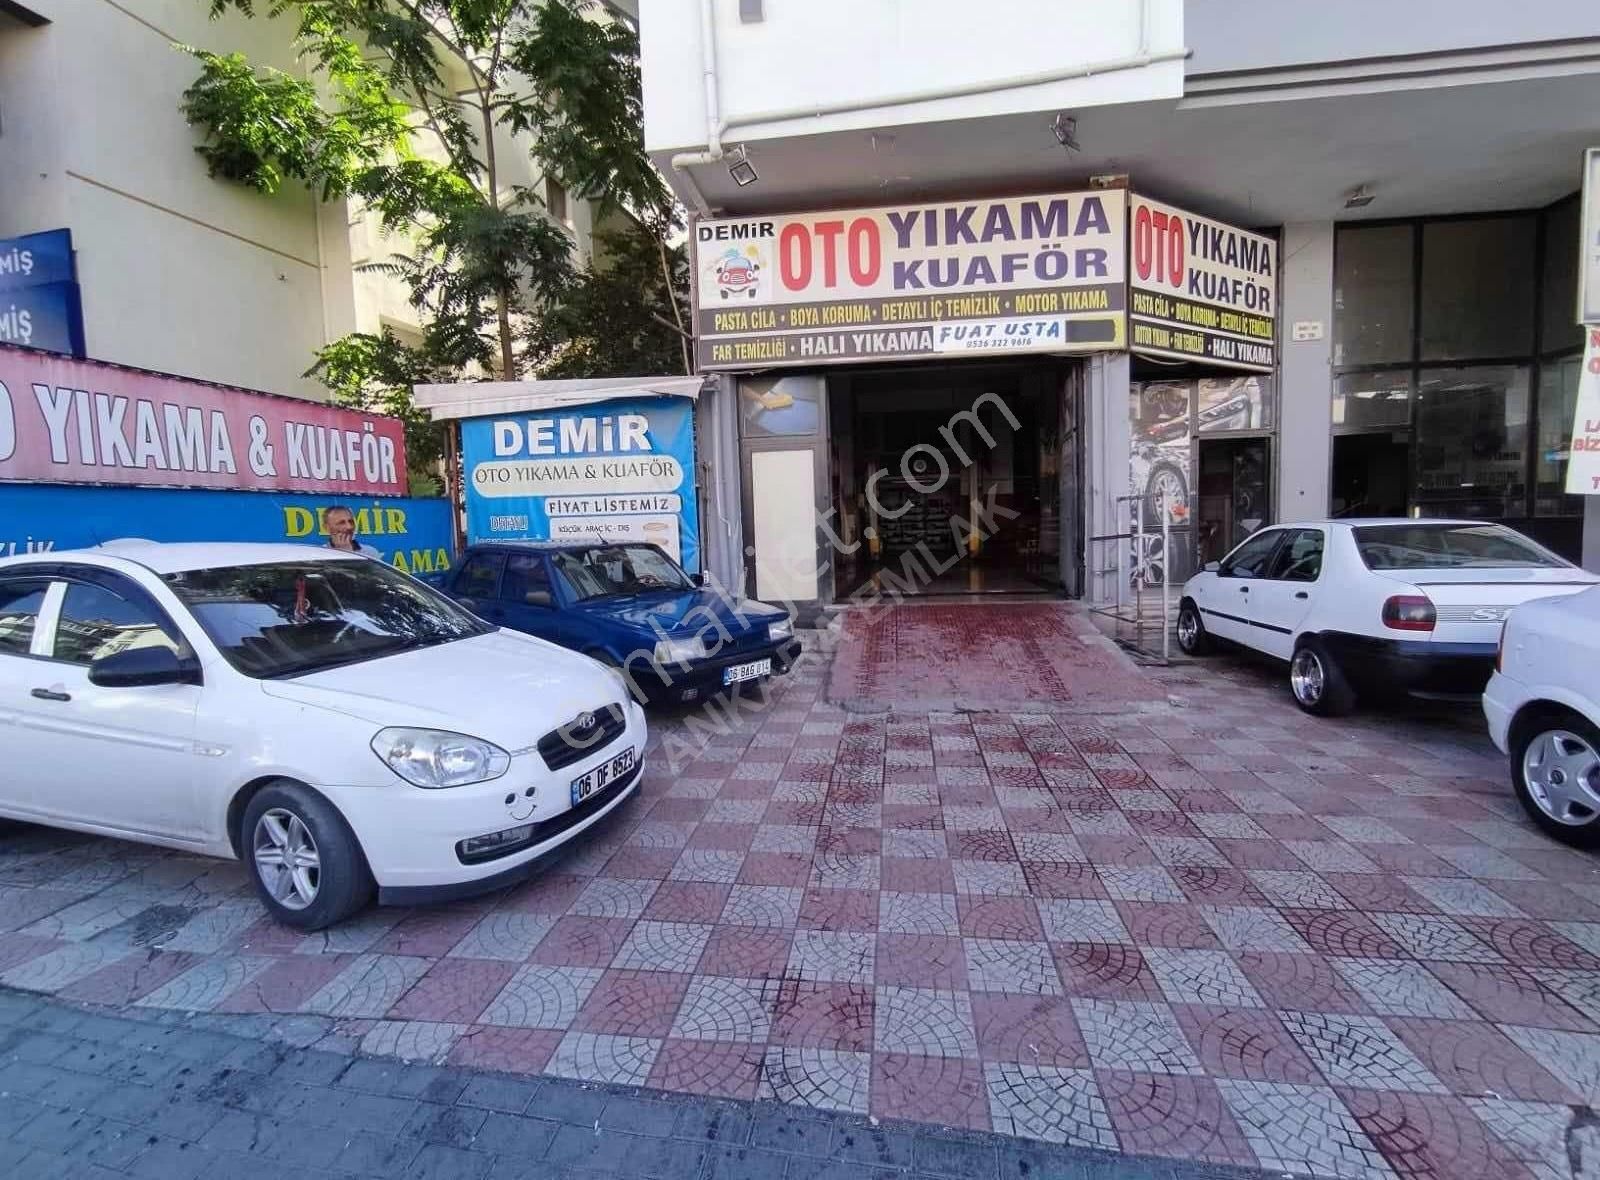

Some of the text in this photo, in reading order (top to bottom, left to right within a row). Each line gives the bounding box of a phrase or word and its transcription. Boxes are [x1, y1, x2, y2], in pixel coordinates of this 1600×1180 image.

[886, 196, 1111, 249] YIKAMA
[780, 217, 881, 291] OTO
[893, 243, 1108, 290] KUAFÖR
[1135, 204, 1184, 288] OTO
[1186, 219, 1272, 276] YIKAMA
[715, 313, 748, 331] PASTA
[751, 307, 776, 328] CİLA
[790, 306, 819, 326] BOYA
[822, 303, 871, 324] KORUMA
[882, 299, 927, 321] DETAYLI
[947, 292, 1000, 317] TEMİZLİK
[1015, 294, 1058, 313] MOTOR
[1061, 290, 1108, 310] YIKAMA
[1188, 267, 1270, 313] KUAFÖR
[713, 344, 732, 361] FAR
[801, 335, 845, 356] HALI
[852, 327, 933, 353] YIKAMA
[940, 321, 1059, 343] FUAT USTA
[991, 338, 1008, 347] 322
[1213, 338, 1235, 359] HALI
[1238, 344, 1272, 364] YIKAMA
[32, 383, 237, 475] YIKAMA
[248, 415, 277, 478] &
[285, 422, 397, 484] KUAFÖR
[475, 459, 674, 484] OTO YIKAMA & KUAFÖR
[549, 498, 669, 513] FİYAT LİSTEMİZ
[579, 750, 633, 799] 06 DF 8523
